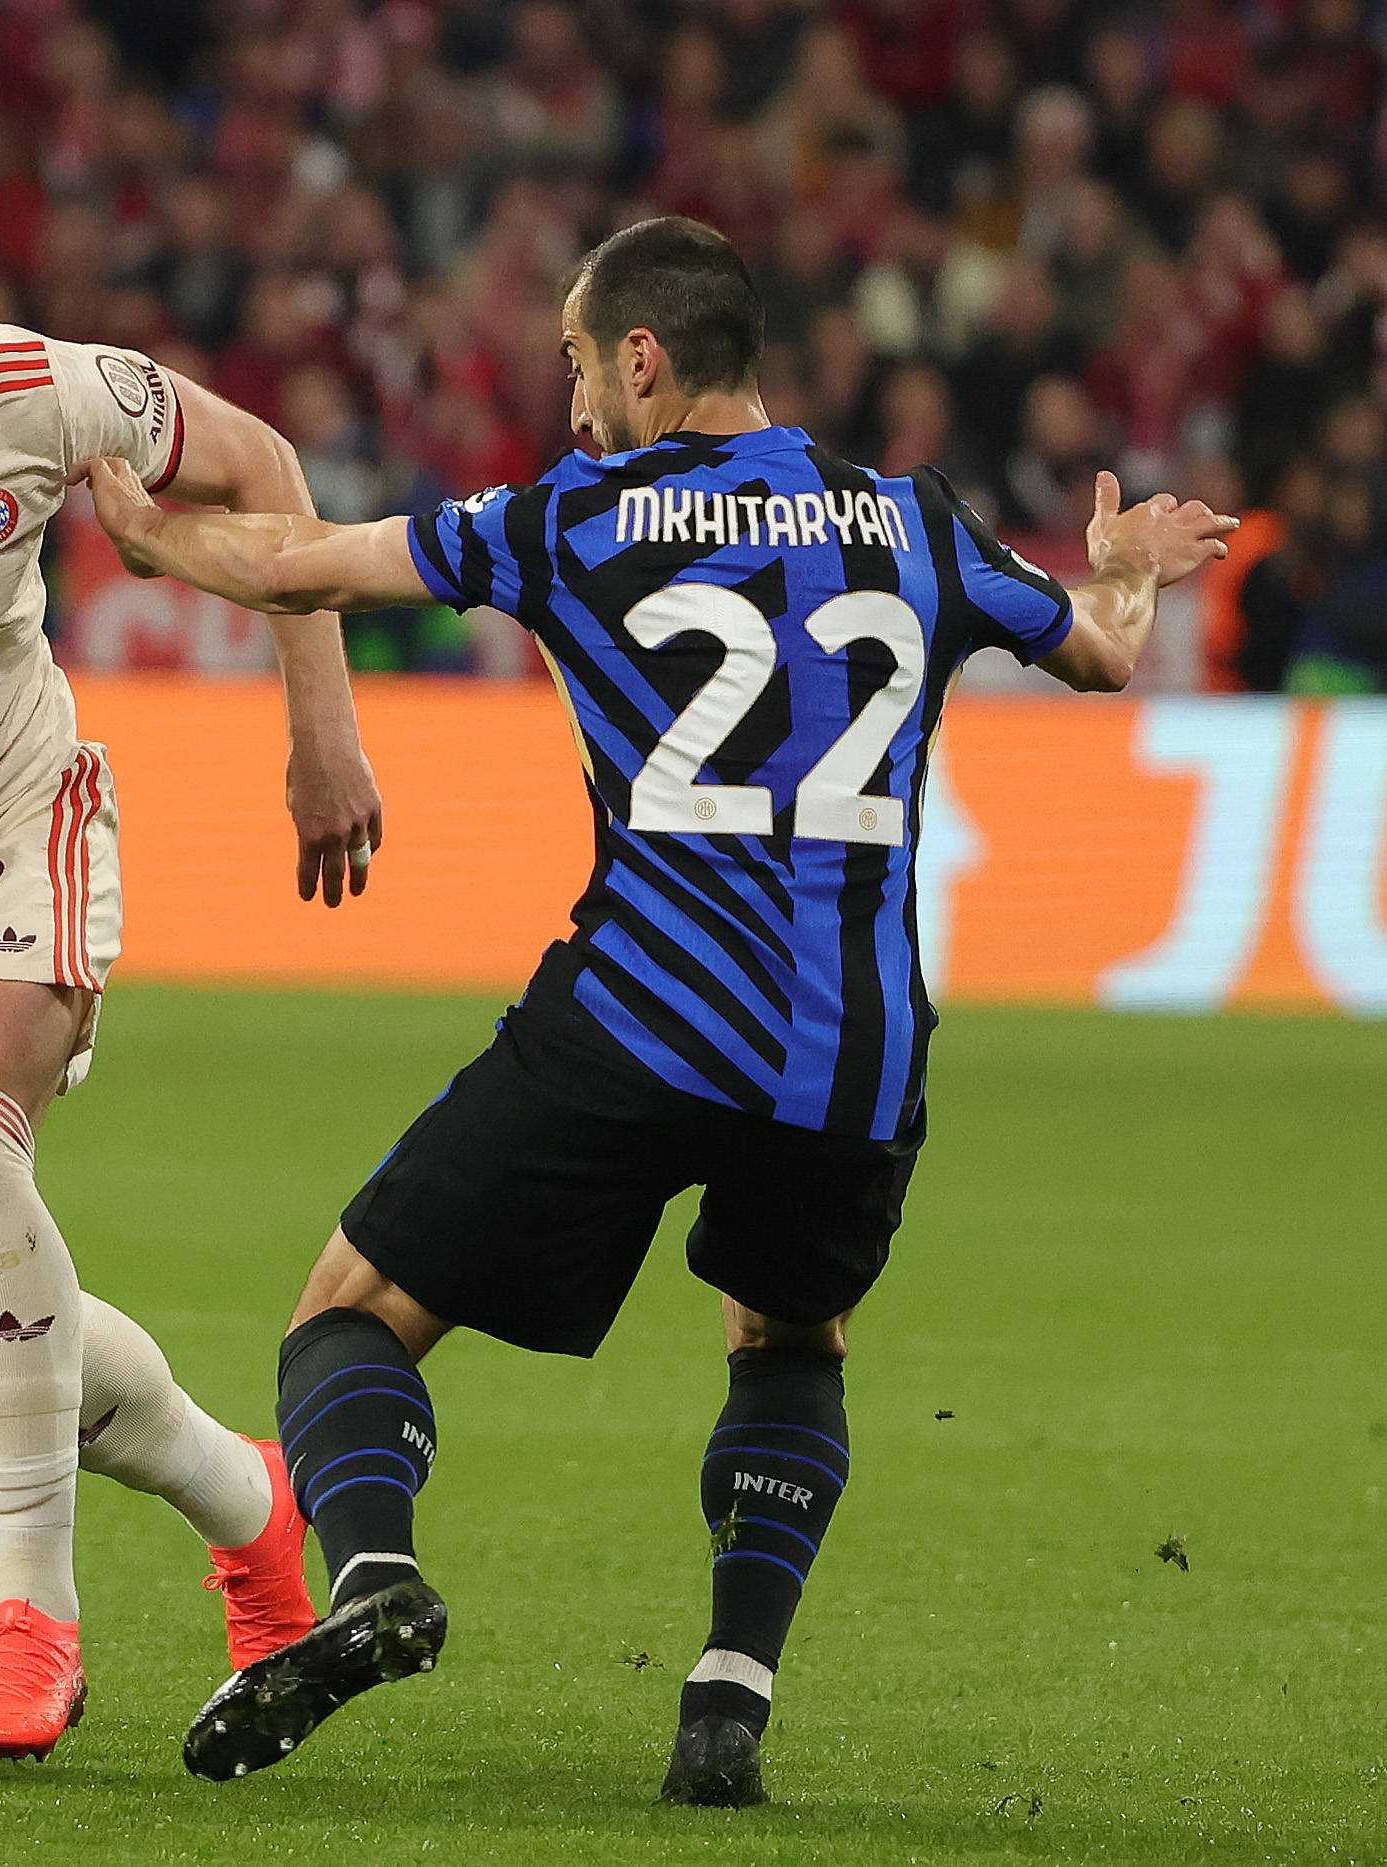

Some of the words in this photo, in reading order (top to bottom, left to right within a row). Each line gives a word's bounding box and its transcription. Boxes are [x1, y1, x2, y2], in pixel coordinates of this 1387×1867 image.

[140, 361, 166, 445] Allianz
[615, 486, 910, 552] MKHITARYAN
[622, 582, 926, 848] 22
[733, 1471, 814, 1511] INTER
